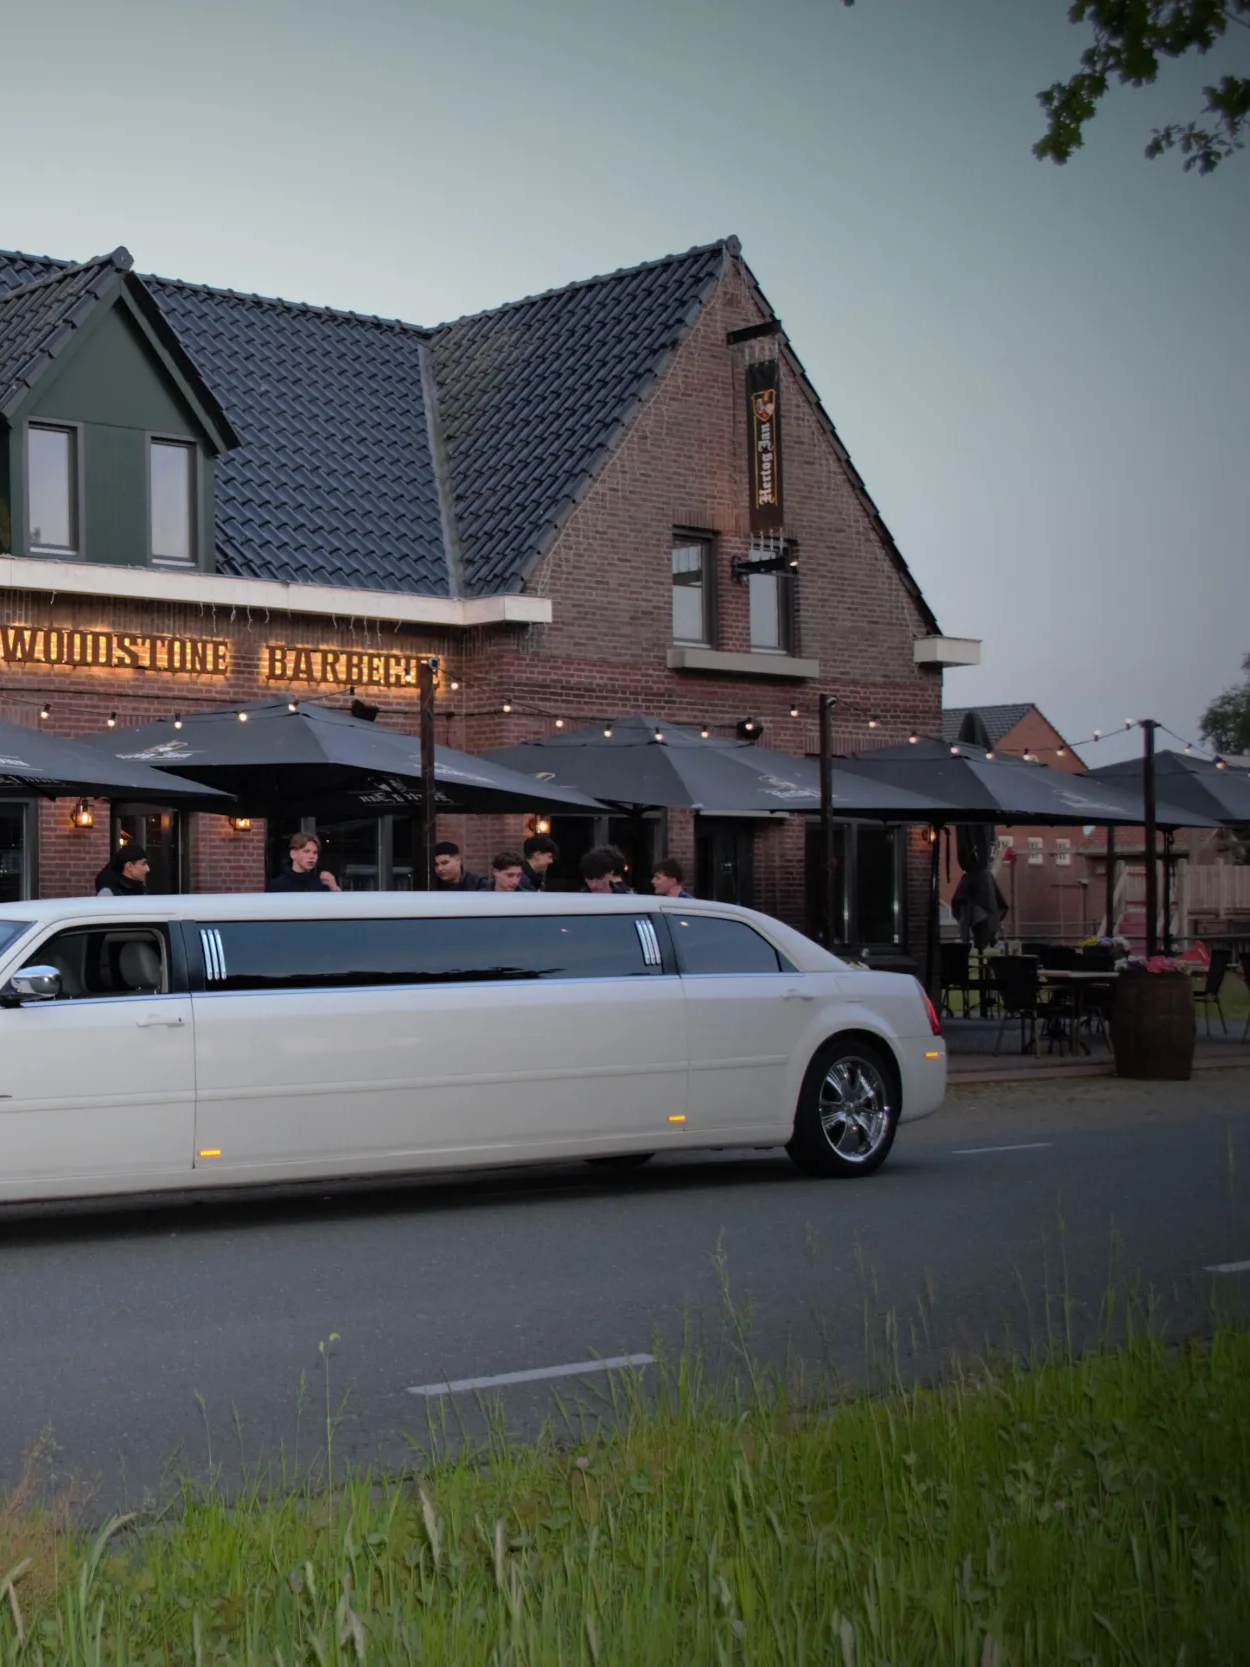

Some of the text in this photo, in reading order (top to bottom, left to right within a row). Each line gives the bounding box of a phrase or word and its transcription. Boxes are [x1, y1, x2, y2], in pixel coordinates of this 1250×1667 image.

[758, 423, 775, 505] Hertog Jan
[0, 626, 229, 676] WOODSTONE
